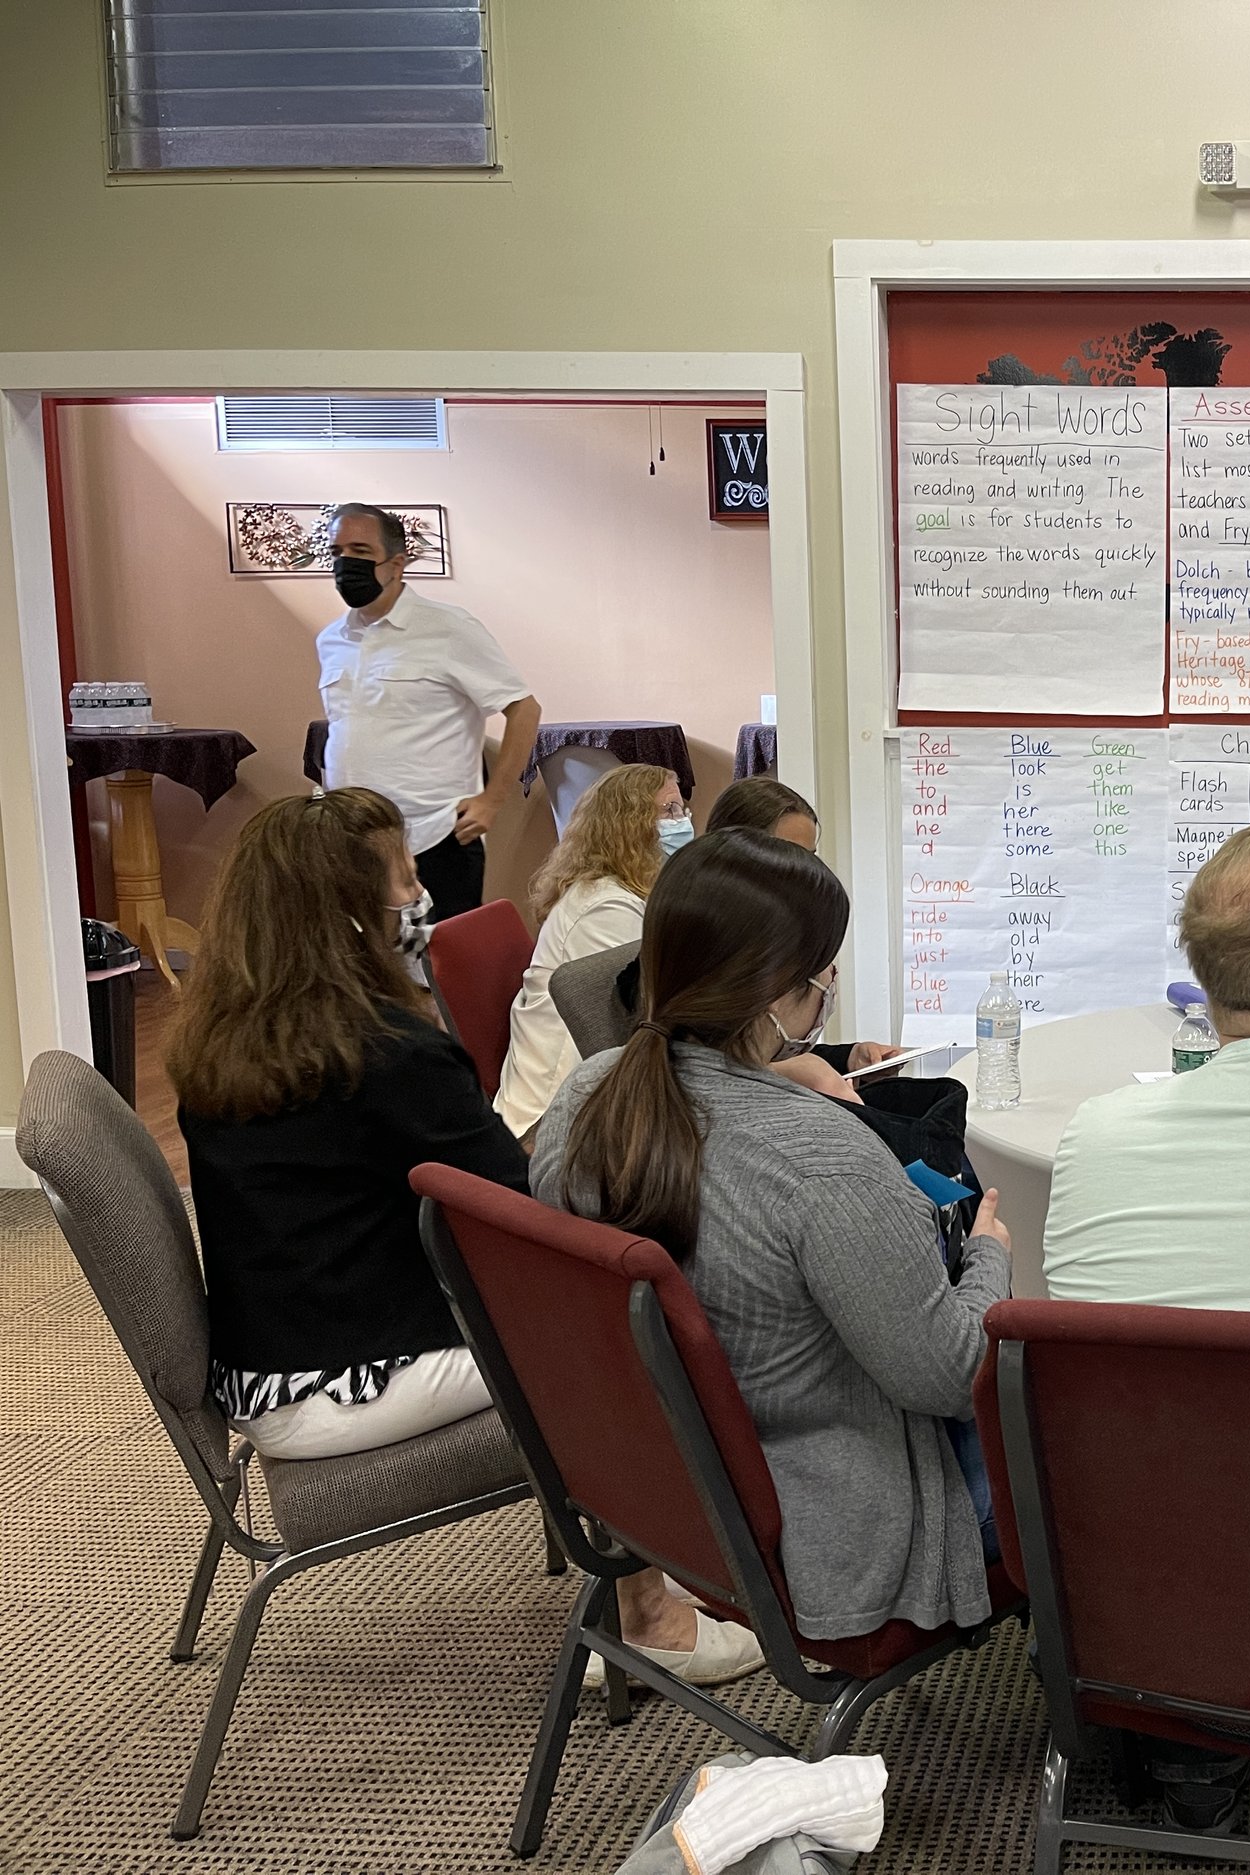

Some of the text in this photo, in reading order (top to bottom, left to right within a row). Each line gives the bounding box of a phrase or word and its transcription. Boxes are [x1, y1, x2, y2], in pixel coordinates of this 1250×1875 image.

[936, 392, 1146, 444] Sight Words
[1178, 428, 1208, 448] Two
[719, 433, 764, 474] W
[912, 445, 1120, 474] words frequently used in
[1181, 456, 1211, 477] list
[914, 478, 974, 503] reading
[987, 479, 1016, 499] and
[1108, 477, 1144, 498] The
[1177, 488, 1246, 509] teachers
[916, 507, 1133, 532] goal is for students to
[1178, 520, 1210, 539] and
[1224, 517, 1250, 545] Fry
[914, 543, 1156, 571] recognize the words quickly
[913, 578, 972, 598] without
[981, 581, 1049, 605] sounding
[1063, 581, 1103, 601] them
[1178, 583, 1249, 606] frequency
[1180, 601, 1236, 625] typically
[1177, 651, 1245, 675] Heritage
[1177, 670, 1223, 688] whose
[1177, 690, 1230, 712] reading
[919, 732, 951, 755] Red
[1011, 734, 1053, 755] Blue
[1091, 734, 1135, 756] Green
[911, 760, 949, 776] the
[1011, 759, 1047, 777] look
[1093, 760, 1128, 782] get
[915, 780, 937, 798] to
[1016, 779, 1032, 800] is
[1085, 781, 1133, 796] them
[1180, 771, 1227, 793] Flash
[912, 795, 947, 816] and
[1003, 802, 1039, 819] her
[1095, 801, 1130, 818] like
[1180, 795, 1224, 812] cards
[916, 820, 942, 836] he
[1002, 822, 1053, 838] there
[1093, 823, 1129, 836] one
[1005, 842, 1054, 857] some
[1095, 839, 1127, 856] this
[1177, 849, 1215, 869] spell
[910, 872, 975, 902] Orange
[1010, 872, 1061, 896] Black
[911, 905, 948, 924] ride
[1008, 911, 1051, 932] away
[912, 928, 943, 945] into
[1010, 927, 1040, 947] old
[910, 949, 949, 970] just
[1011, 947, 1035, 971] by
[911, 970, 949, 992] blue
[1006, 970, 1044, 987] their
[915, 995, 943, 1013] red
